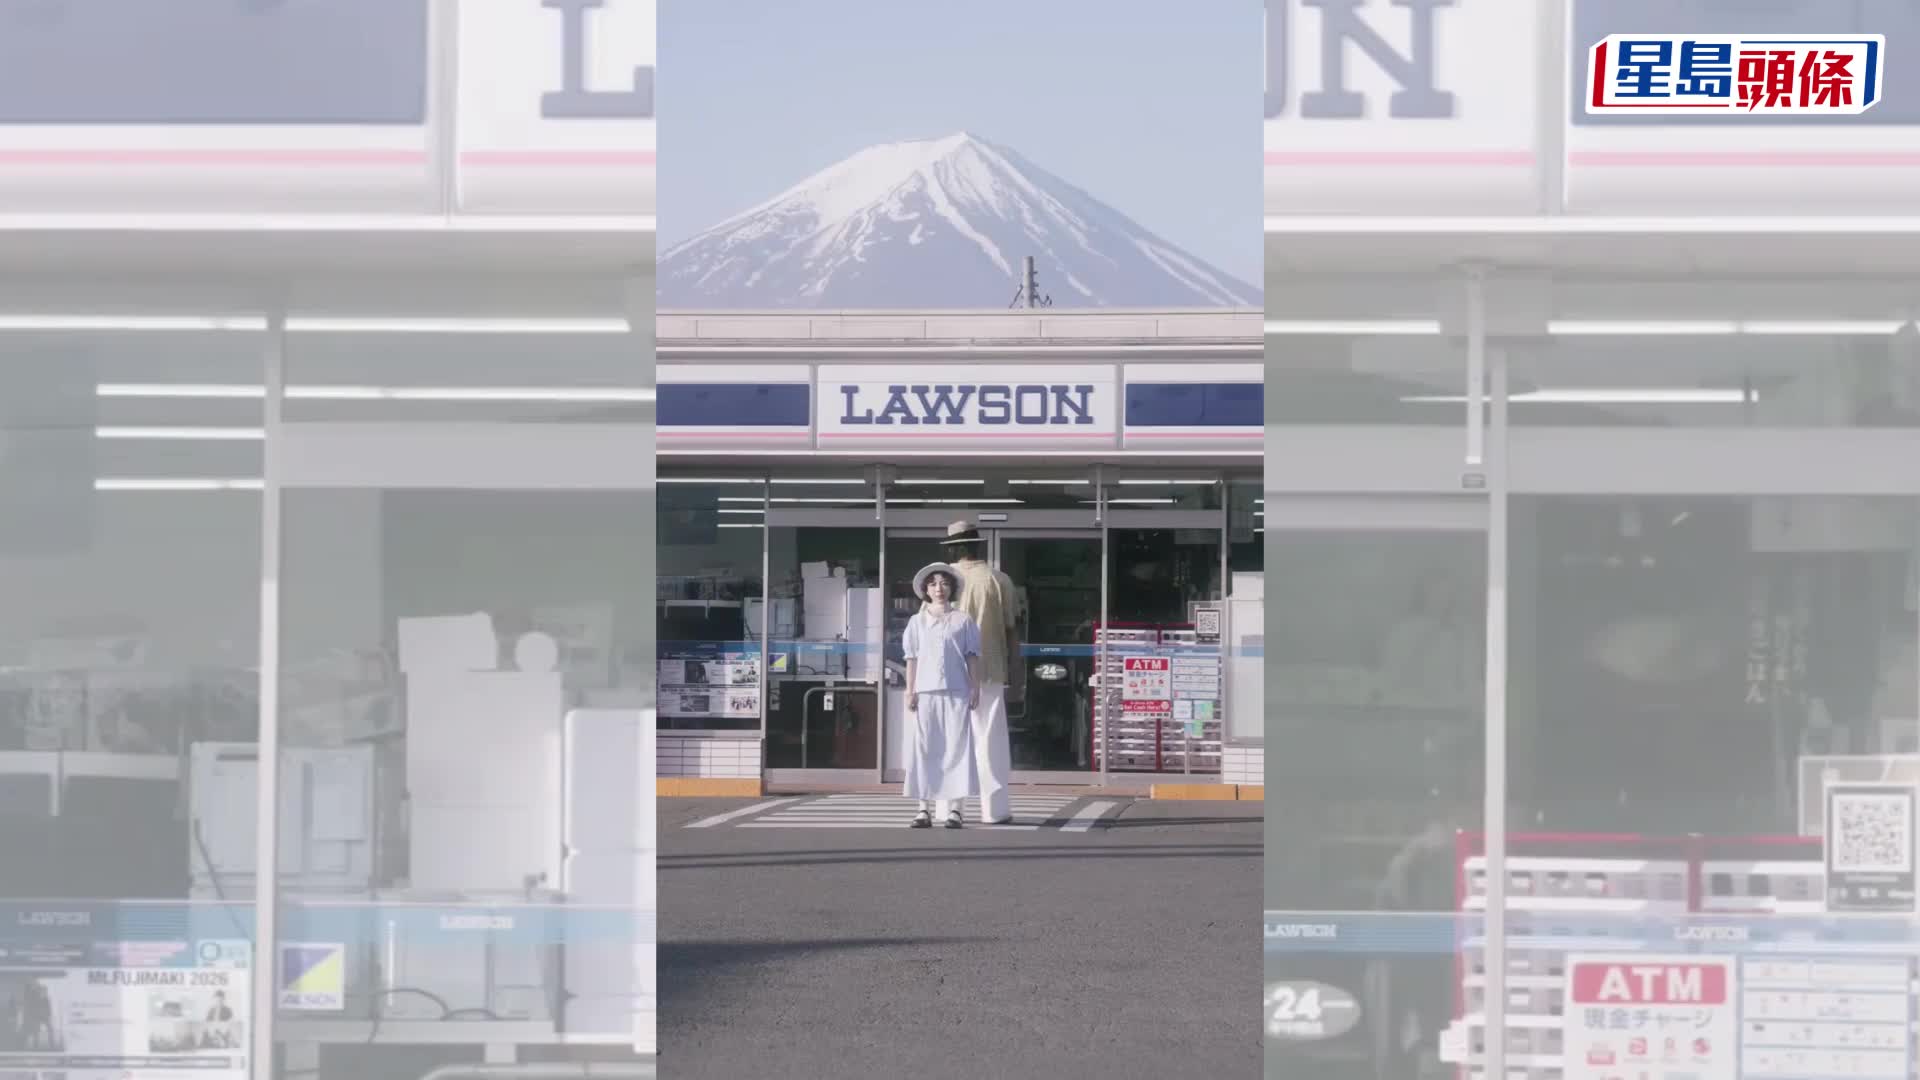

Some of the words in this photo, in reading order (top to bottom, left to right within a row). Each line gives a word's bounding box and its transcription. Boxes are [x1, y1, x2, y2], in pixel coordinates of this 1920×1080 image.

[840, 384, 1094, 425] LAWSON
[1132, 659, 1162, 670] ATM
[189, 971, 230, 986] 2026
[1597, 966, 1703, 1001] ATM
[1272, 985, 1322, 1020] 24
[1584, 1007, 1713, 1031] 現金チャージ
